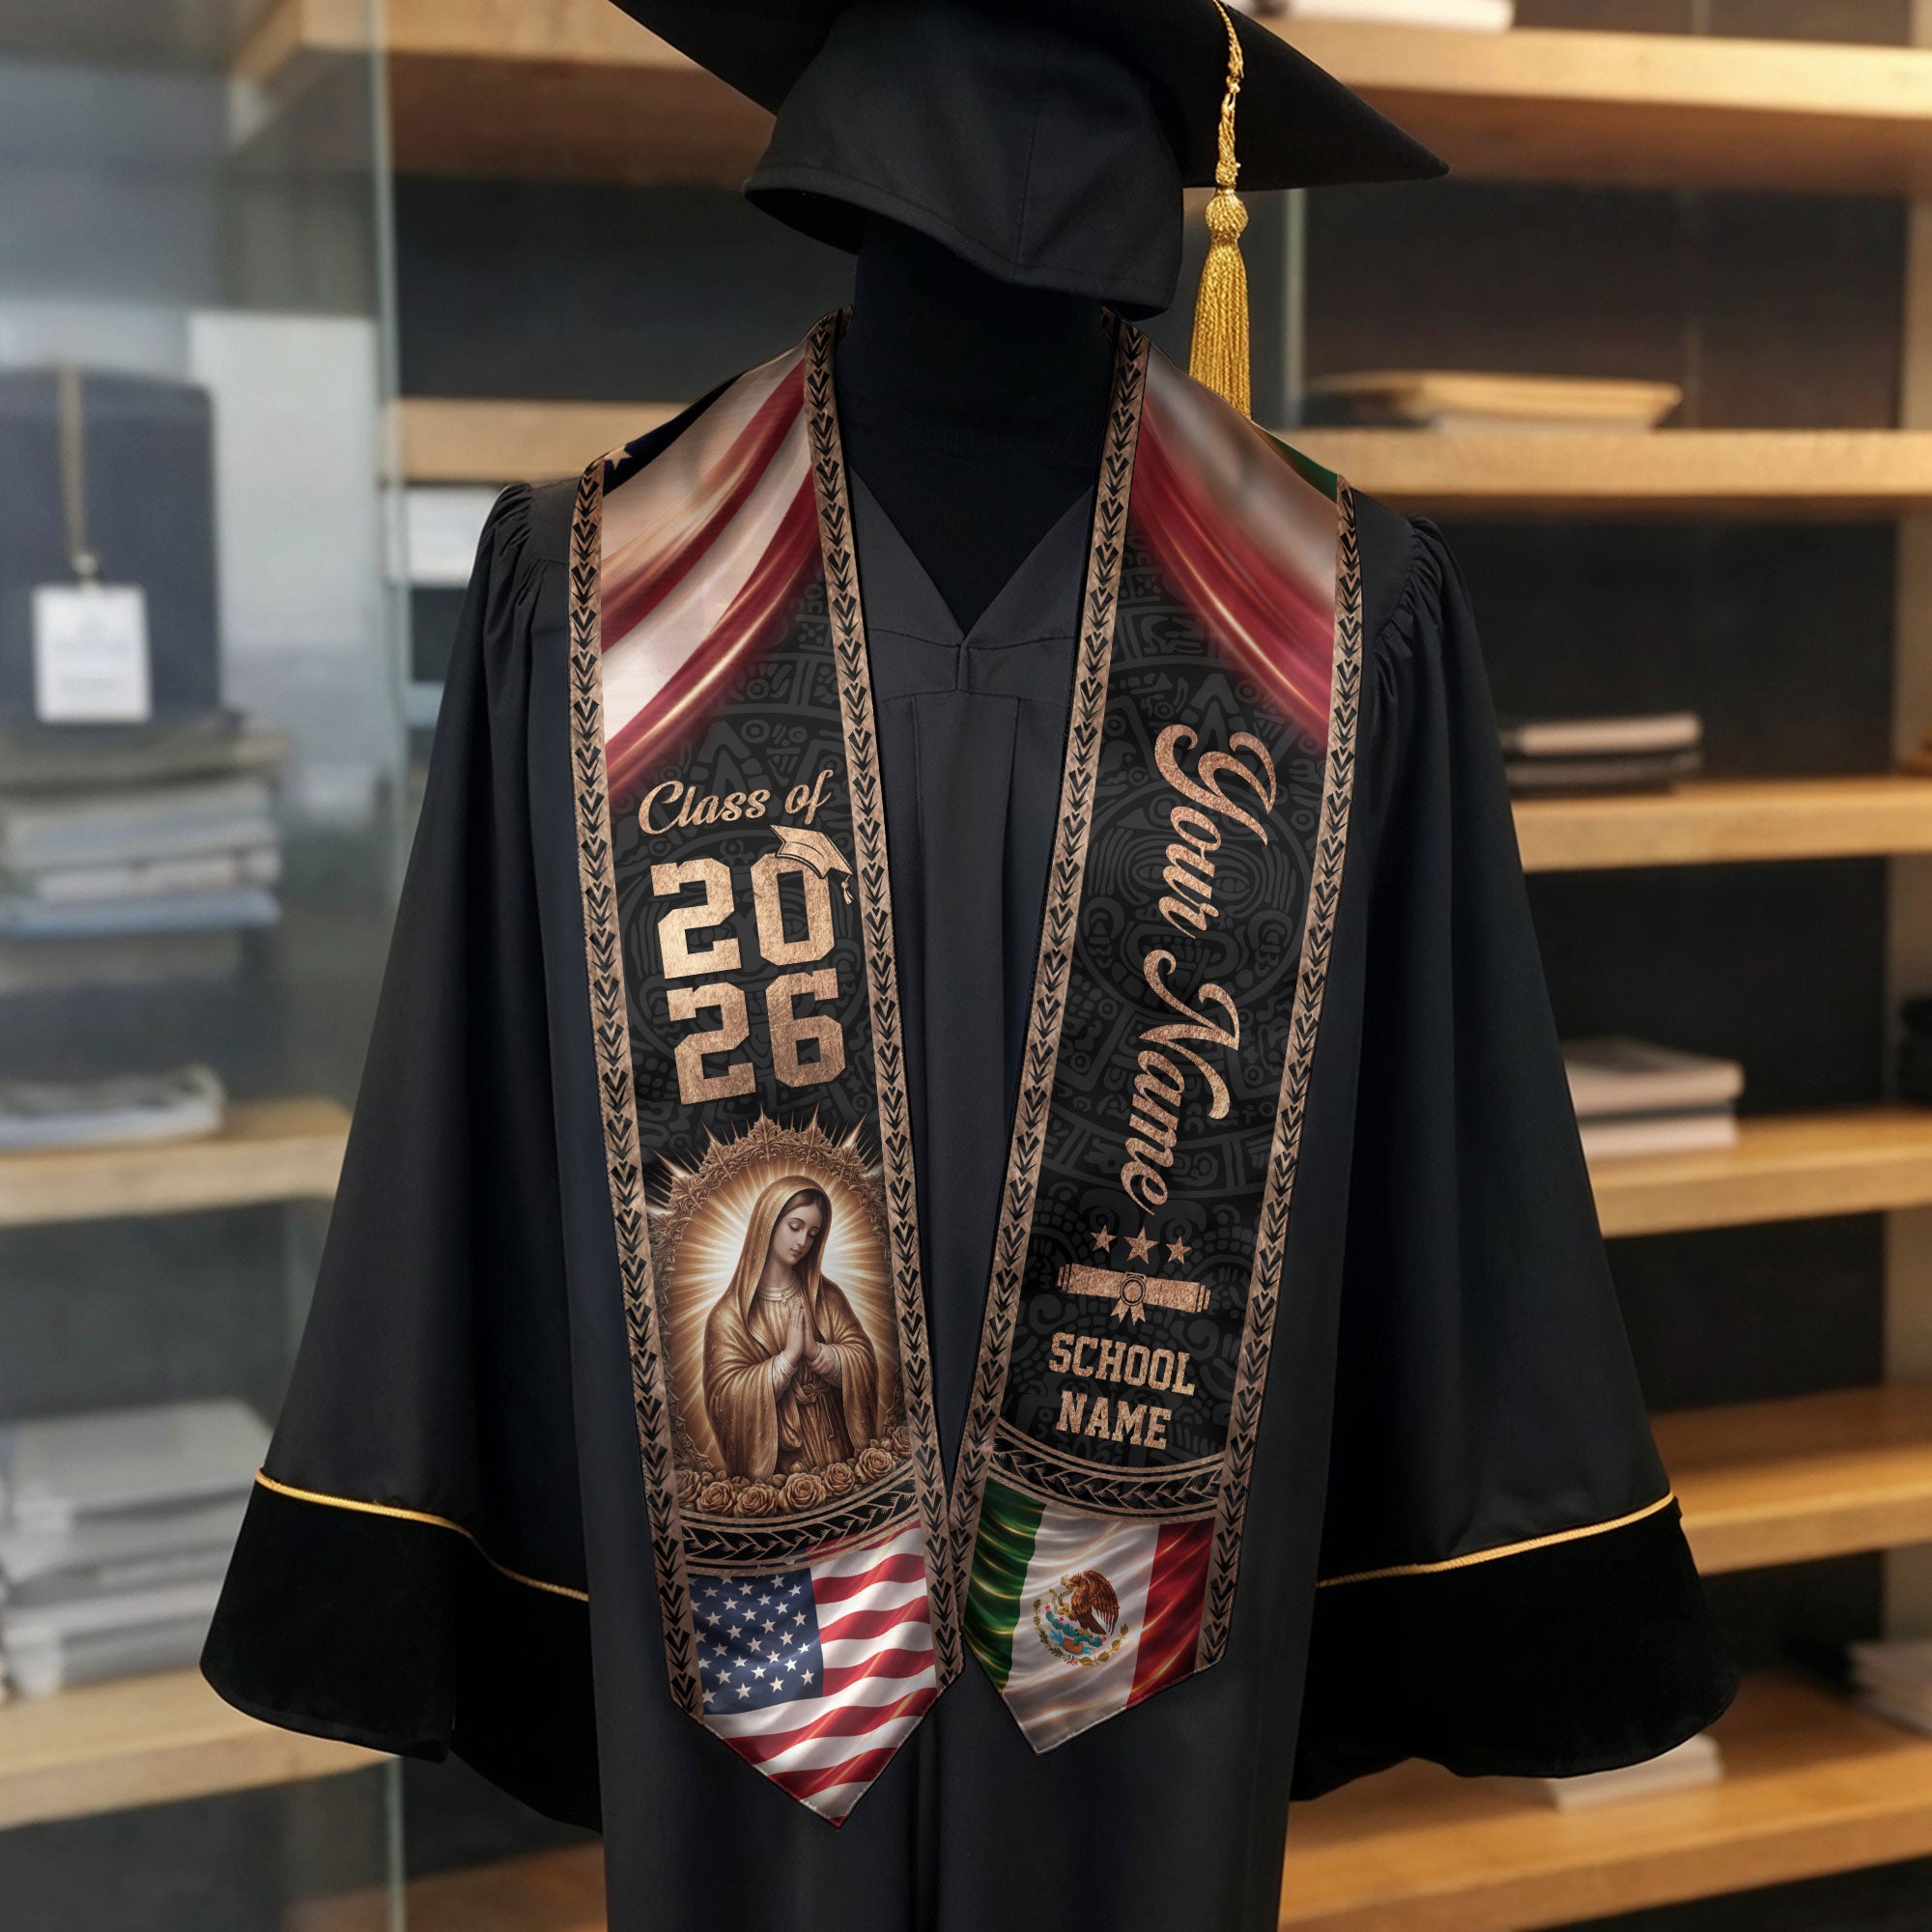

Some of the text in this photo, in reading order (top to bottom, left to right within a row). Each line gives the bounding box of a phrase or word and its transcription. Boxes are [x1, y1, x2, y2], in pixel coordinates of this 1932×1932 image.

[638, 769, 834, 835] Class of
[650, 853, 836, 980] 20
[1121, 724, 1276, 1215] Your Name
[666, 968, 846, 1105] 26
[1048, 1332, 1195, 1396] SCHOOL
[1055, 1391, 1172, 1450] NAME
